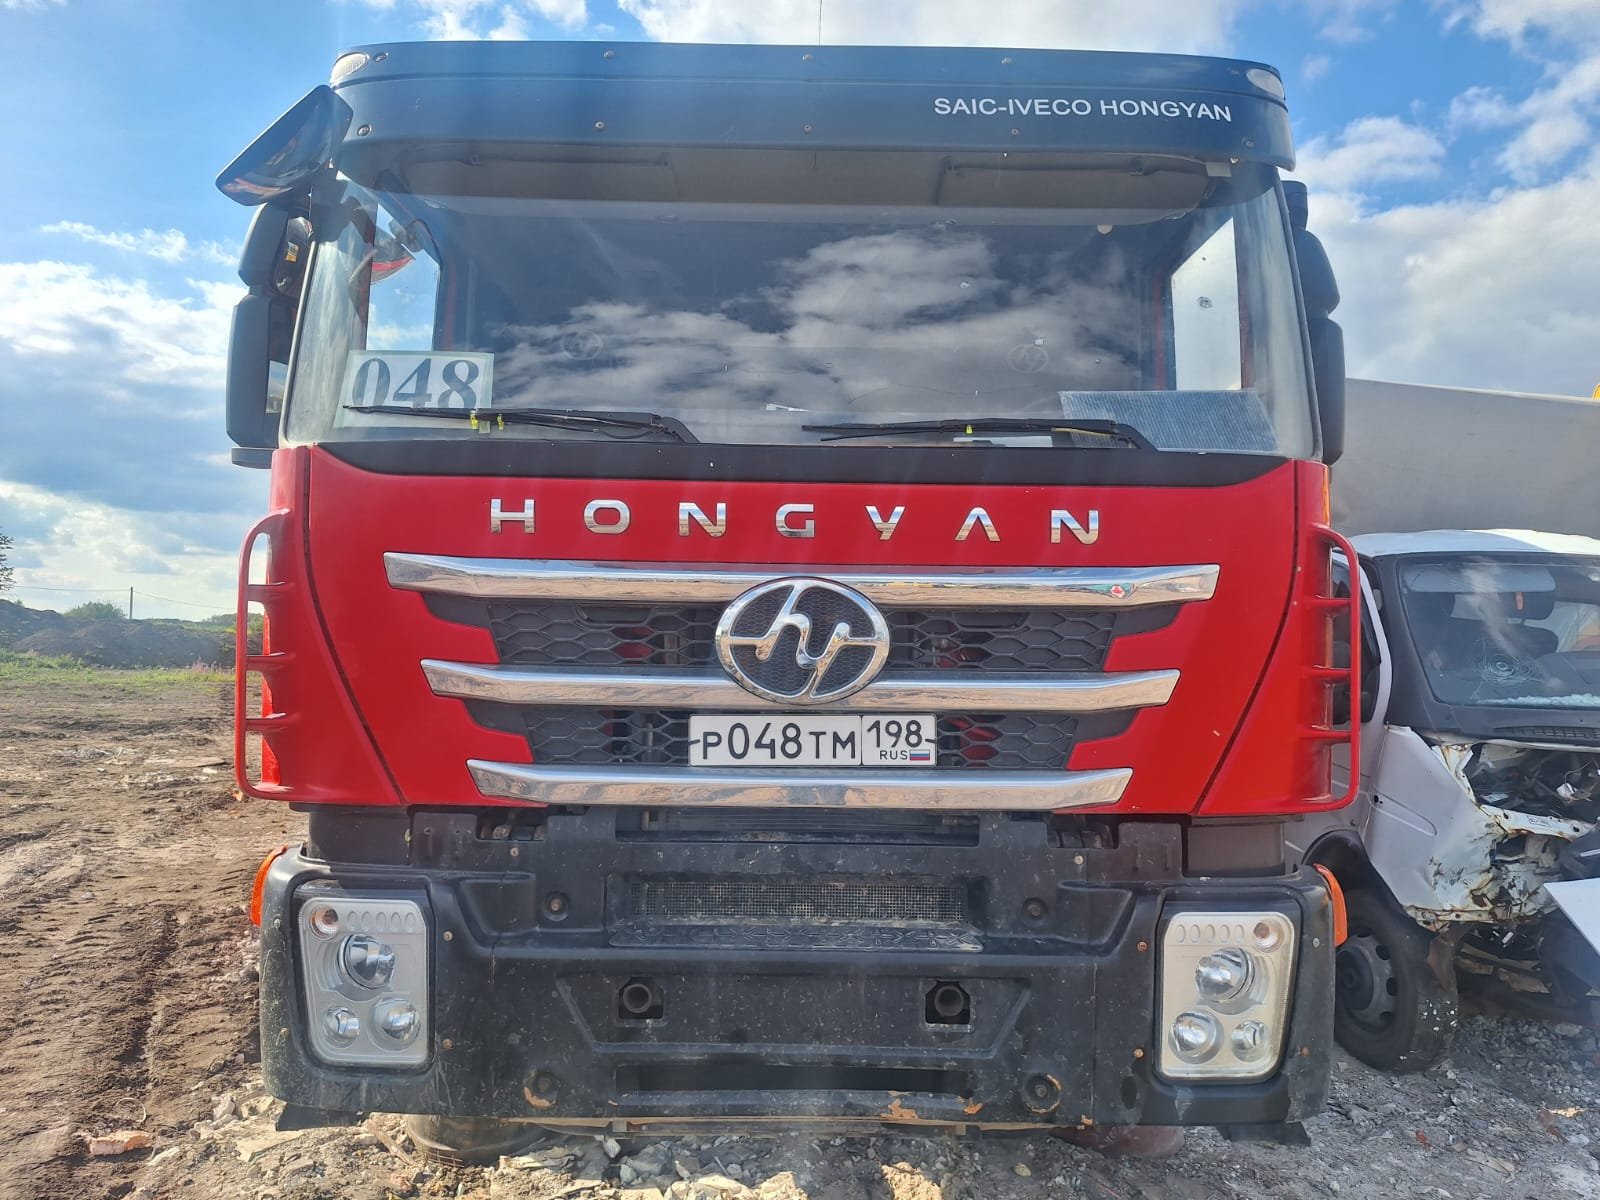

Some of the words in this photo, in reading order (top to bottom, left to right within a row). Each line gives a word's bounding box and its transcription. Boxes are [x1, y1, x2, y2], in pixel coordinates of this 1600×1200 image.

[934, 98, 1092, 116] SAIC-IVECO
[1100, 99, 1232, 122] HONGYAN
[352, 358, 479, 408] 048
[490, 499, 1100, 544] HONGYAN
[866, 720, 922, 748] 198
[879, 750, 908, 760] RUS
